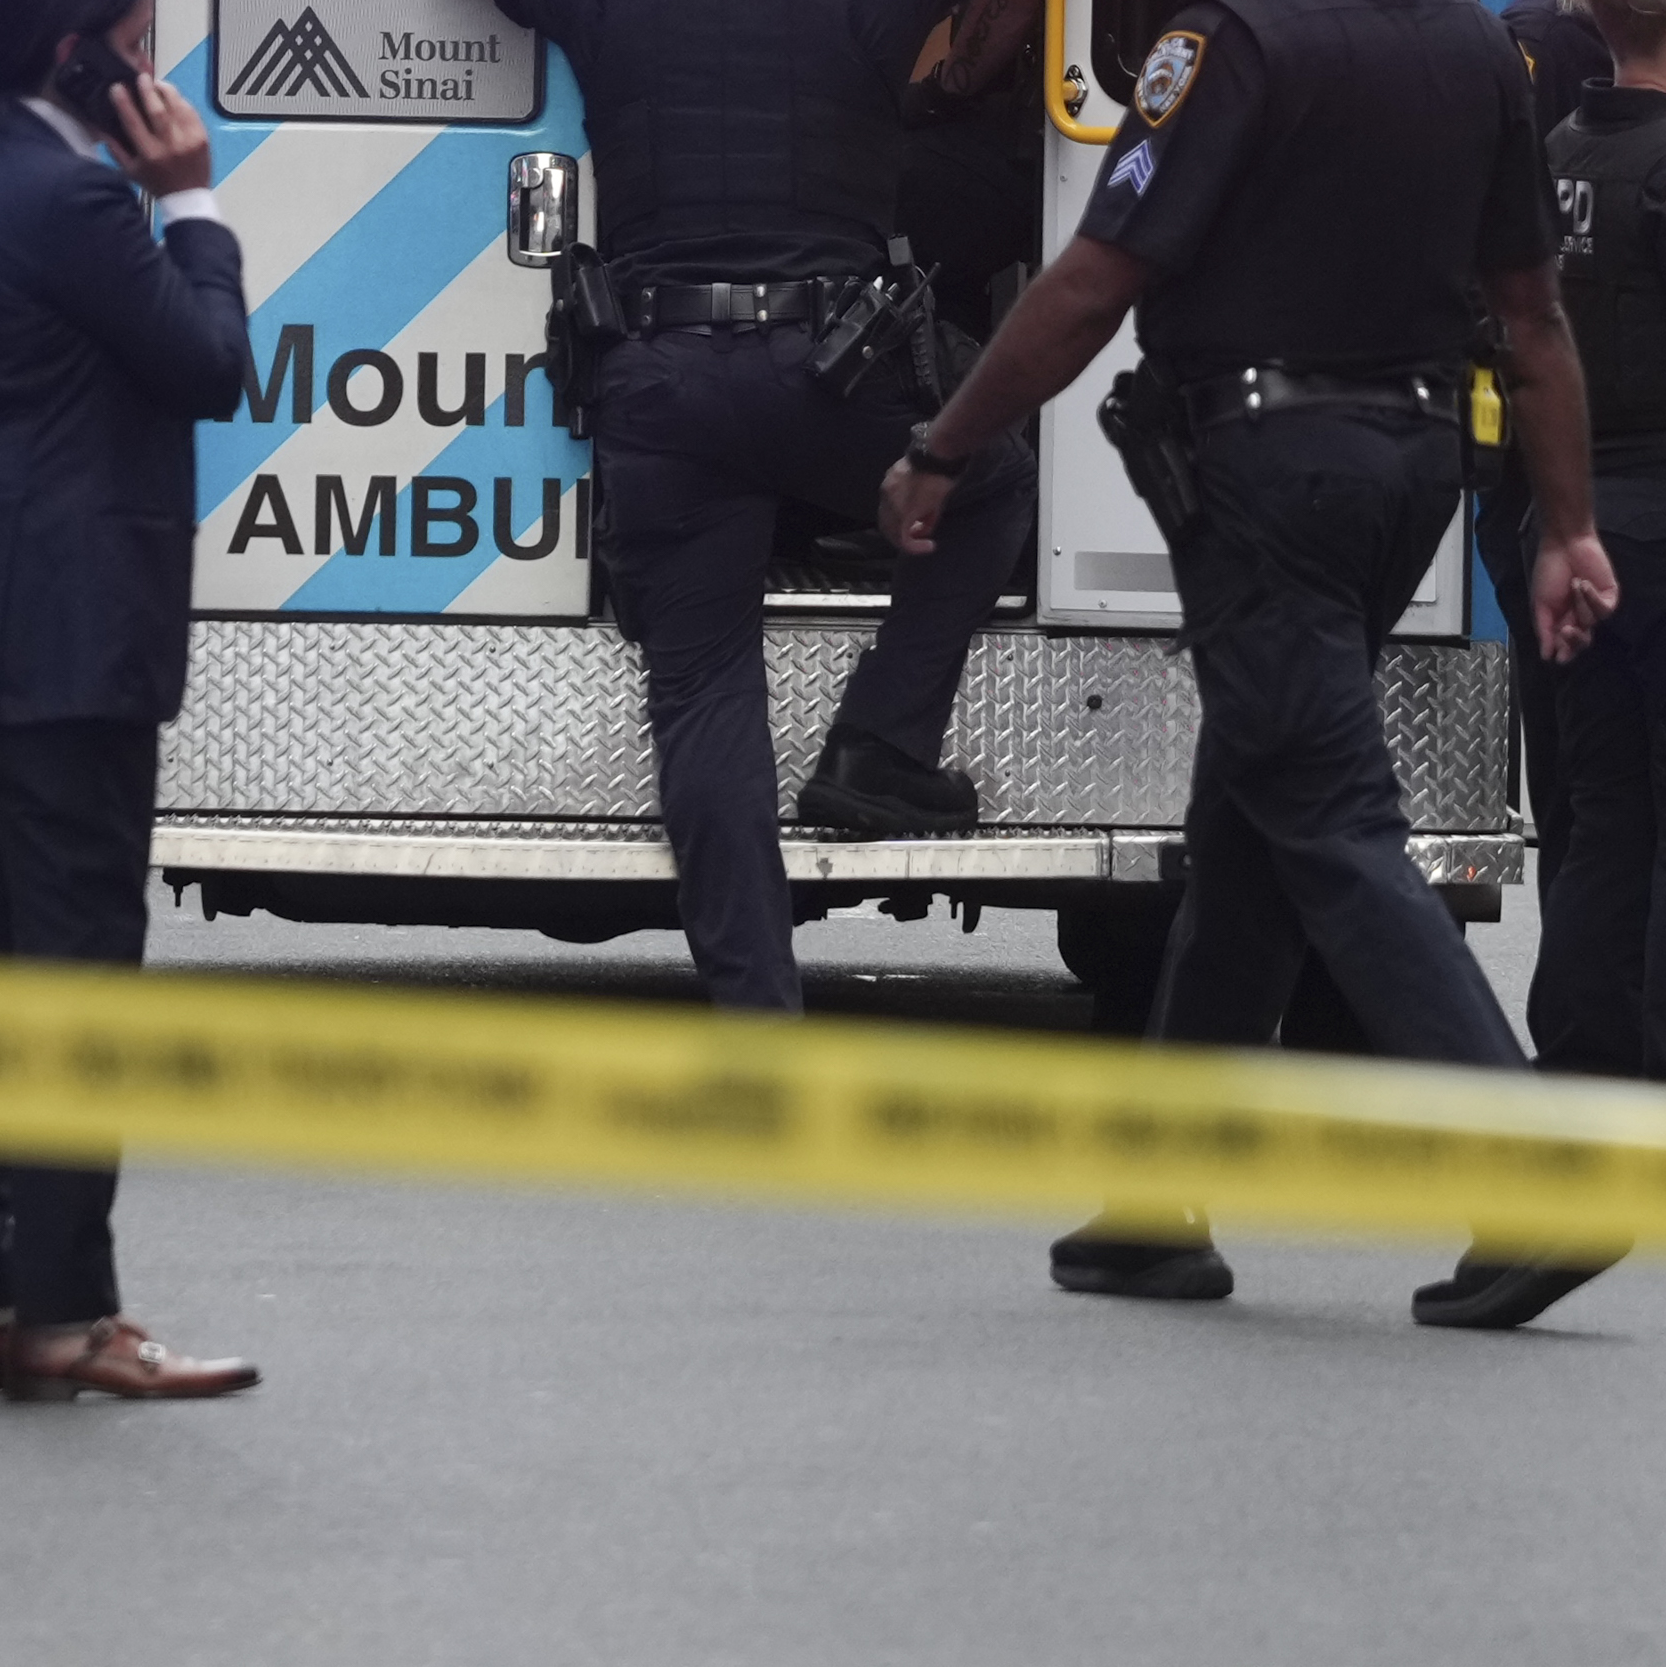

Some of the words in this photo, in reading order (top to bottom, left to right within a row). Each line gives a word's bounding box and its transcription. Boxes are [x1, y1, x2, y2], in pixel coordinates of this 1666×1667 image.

[378, 31, 501, 63] Mount
[379, 68, 475, 101] Sinai
[1557, 178, 1594, 234] PD
